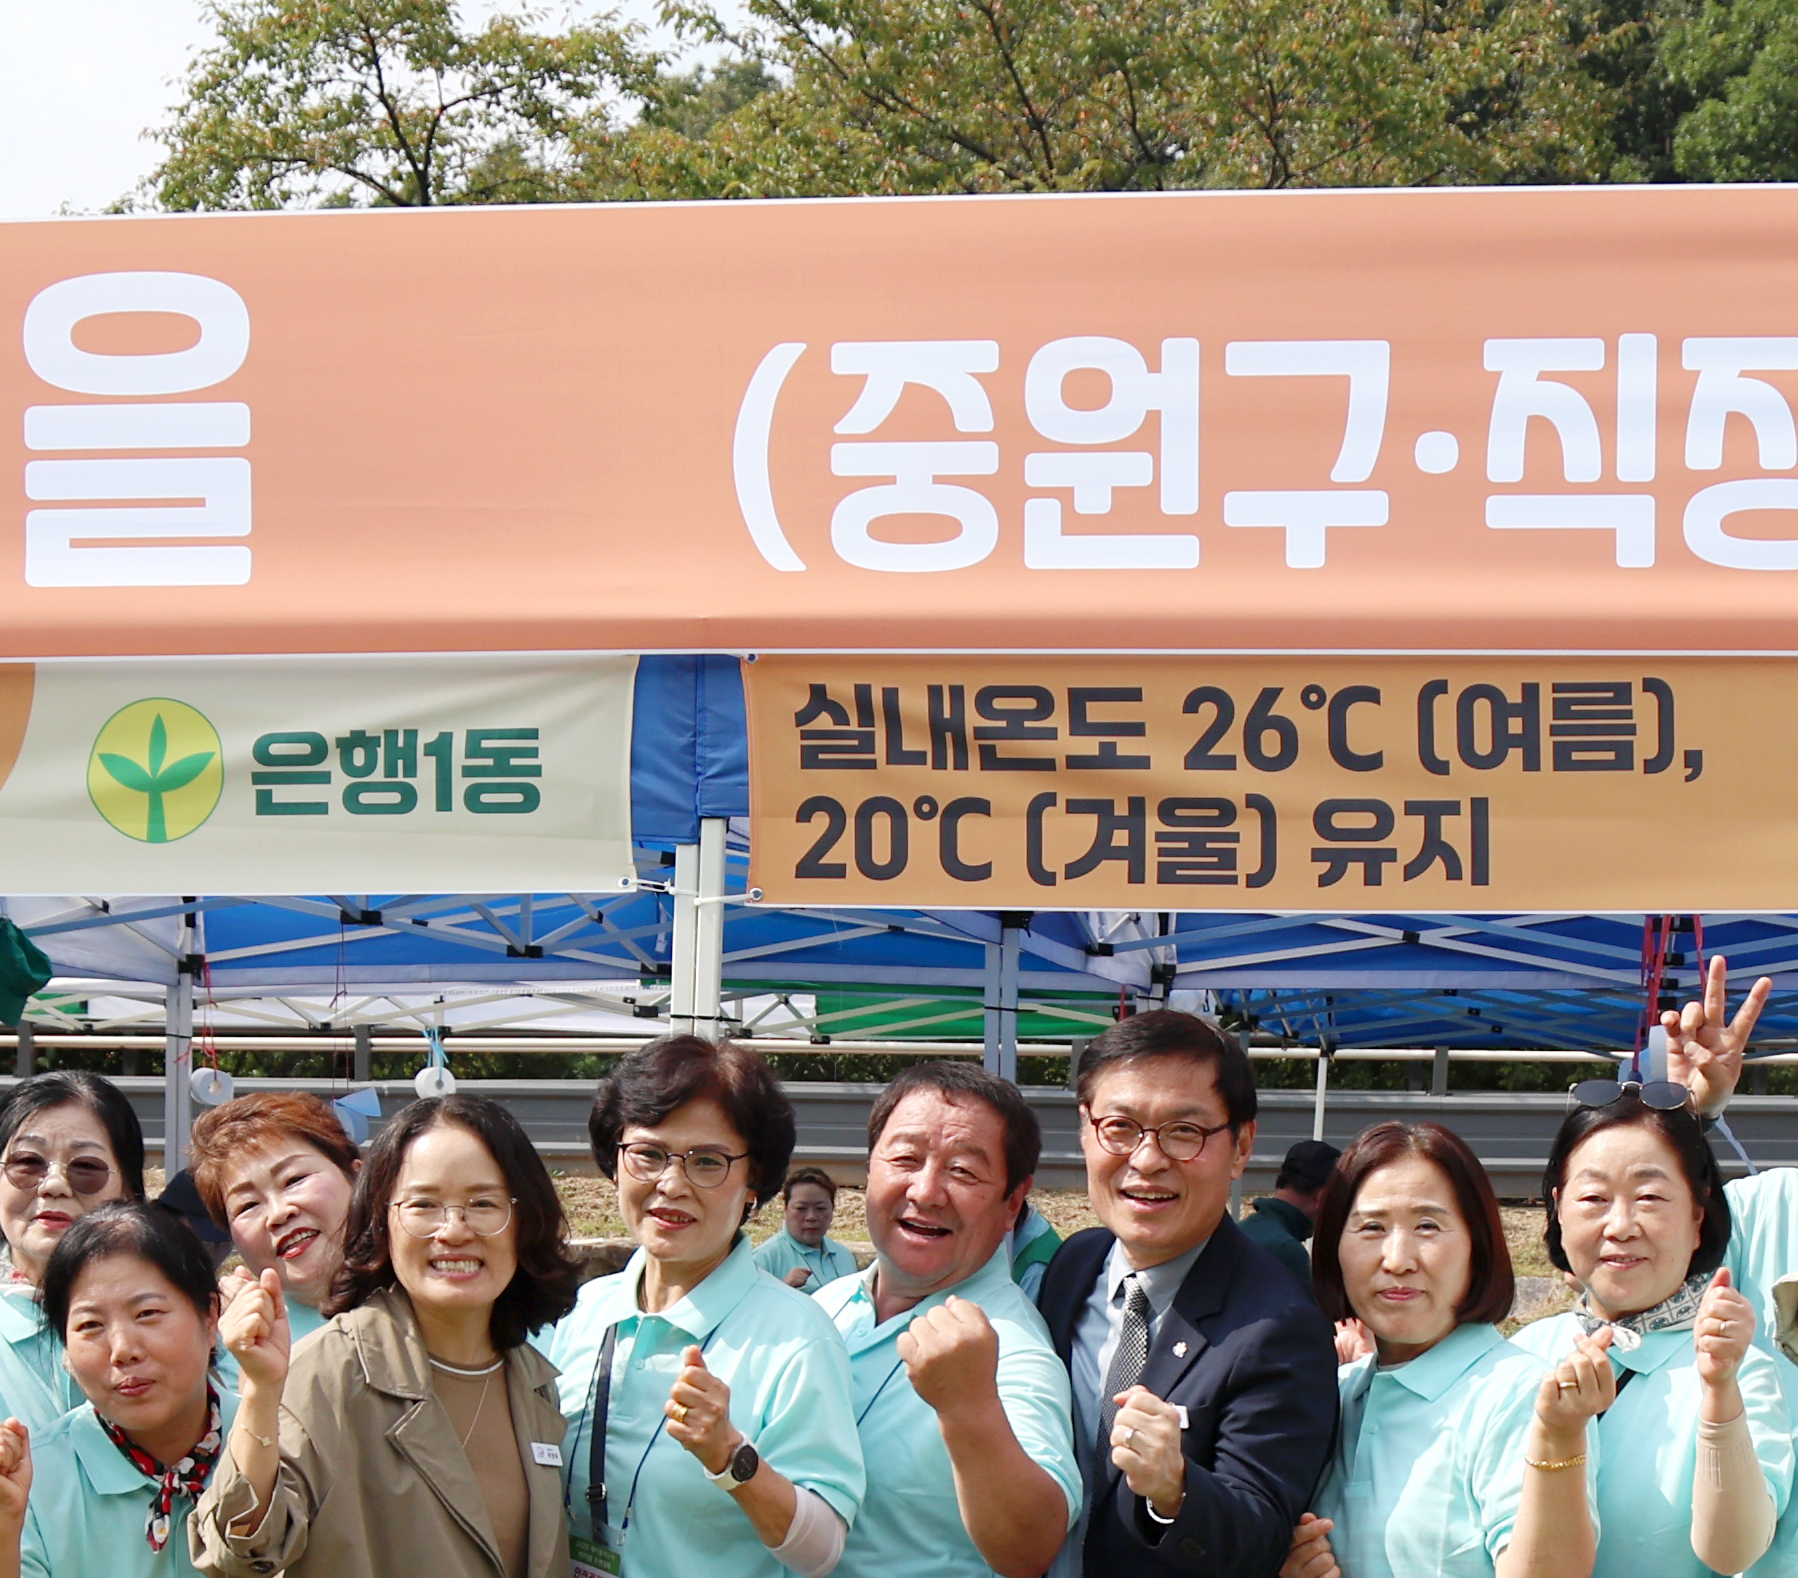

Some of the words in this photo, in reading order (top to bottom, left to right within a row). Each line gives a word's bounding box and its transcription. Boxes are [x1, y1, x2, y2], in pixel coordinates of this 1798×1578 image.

[250, 728, 543, 816] 은행1동
[794, 684, 1151, 772] 실내온도
[1417, 678, 1703, 783] (여름),
[1026, 792, 1277, 889] (겨울)
[1310, 797, 1489, 888] 유지
